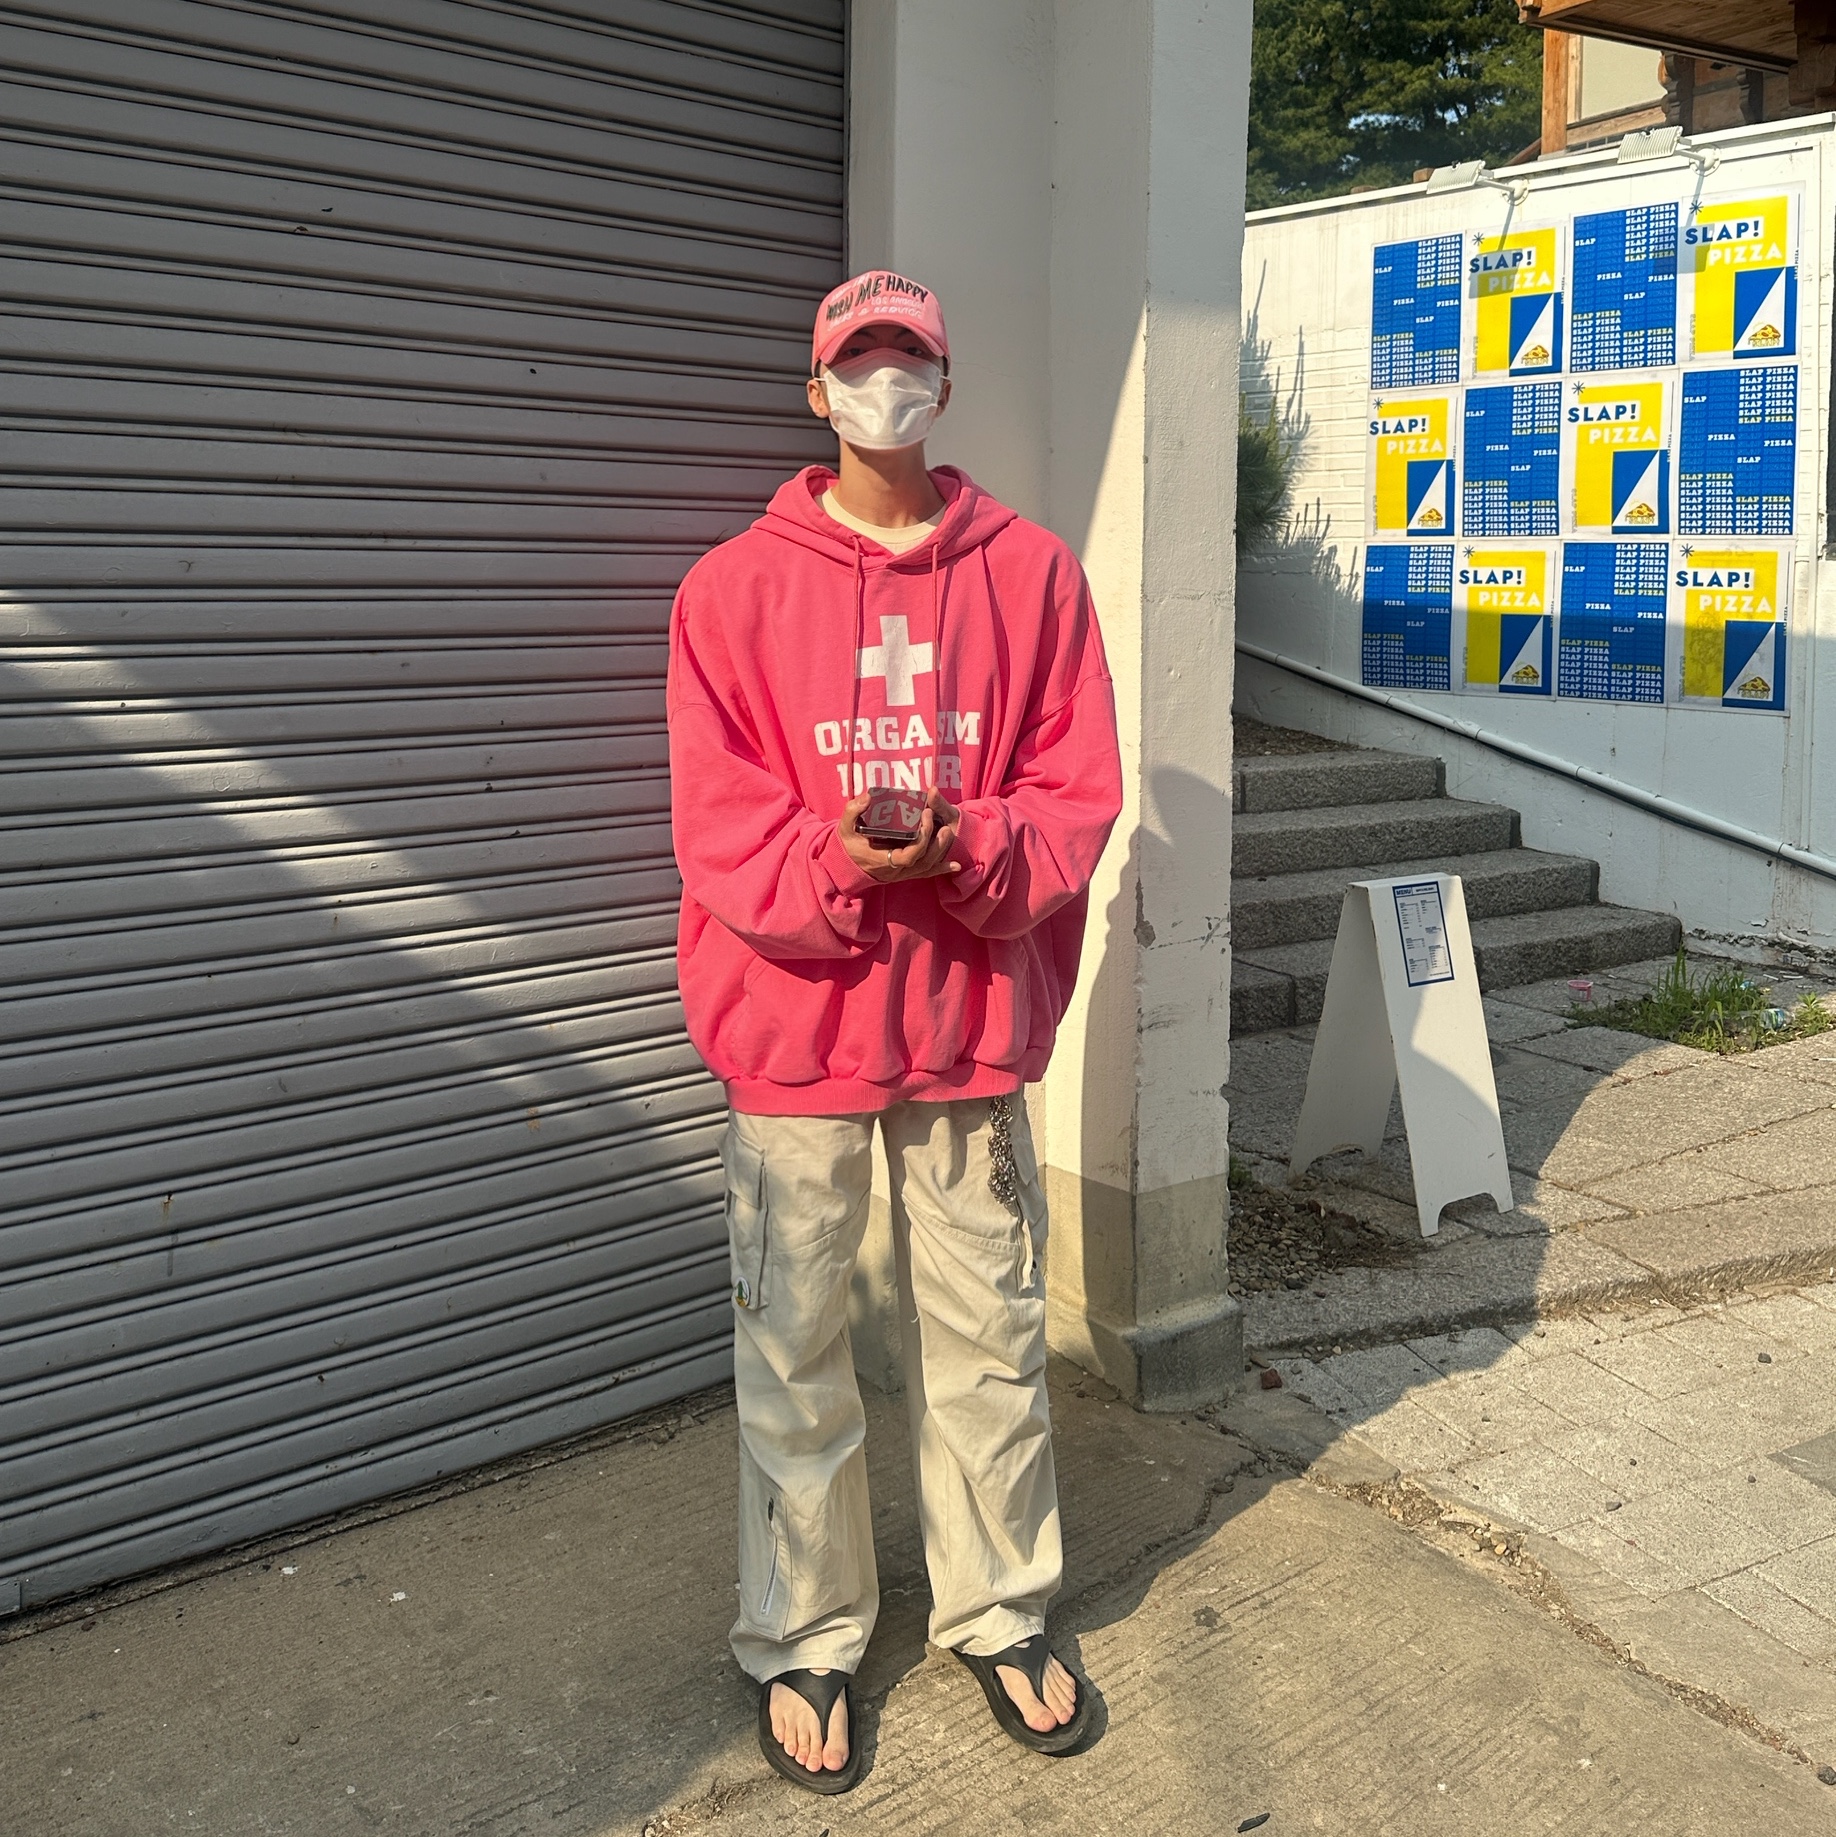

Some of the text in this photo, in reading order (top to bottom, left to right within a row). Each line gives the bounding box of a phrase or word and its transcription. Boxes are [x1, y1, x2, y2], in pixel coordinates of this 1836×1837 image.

[1626, 208, 1647, 217] SLAP
[1626, 215, 1647, 224] SLAP
[1625, 223, 1647, 232] SLAP
[1625, 231, 1647, 240] SLAP
[1685, 220, 1759, 245] SLAP!
[1575, 238, 1596, 246] SLAP
[1625, 238, 1647, 247] SLAP
[1625, 246, 1647, 255] SLAP
[1708, 242, 1782, 266] PIZZA
[1469, 251, 1532, 273] SLAP!
[1625, 254, 1647, 262] SLAP
[1488, 271, 1552, 292] PIZZA
[885, 275, 928, 303] HAPPY
[1624, 292, 1645, 300] SLAP
[1573, 312, 1594, 321] SLAP
[1573, 320, 1593, 328] SLAP
[1573, 327, 1593, 335] SLAP
[1623, 330, 1645, 338] SLAP
[1572, 335, 1593, 343] SLAP
[1623, 337, 1645, 345] SLAP
[1572, 342, 1593, 350] SLAP
[1623, 345, 1645, 353] SLAP
[1572, 350, 1593, 358] SLAP
[1622, 353, 1644, 361] SLAP
[1572, 357, 1592, 365] SLAP
[1623, 360, 1644, 368] SLAP
[1740, 369, 1764, 377] SLAP
[1568, 404, 1636, 422] SLAP!
[1739, 408, 1762, 416] SLAP
[1738, 416, 1762, 424] SLAP
[1370, 418, 1426, 435] SLAP!
[1589, 426, 1657, 444] PIZZA
[1387, 438, 1443, 455] PIZZA
[1459, 570, 1522, 584] SLAP!
[1676, 571, 1750, 588] SLAP!
[1479, 591, 1541, 606] PIZZA
[1700, 595, 1772, 613] PIZZA
